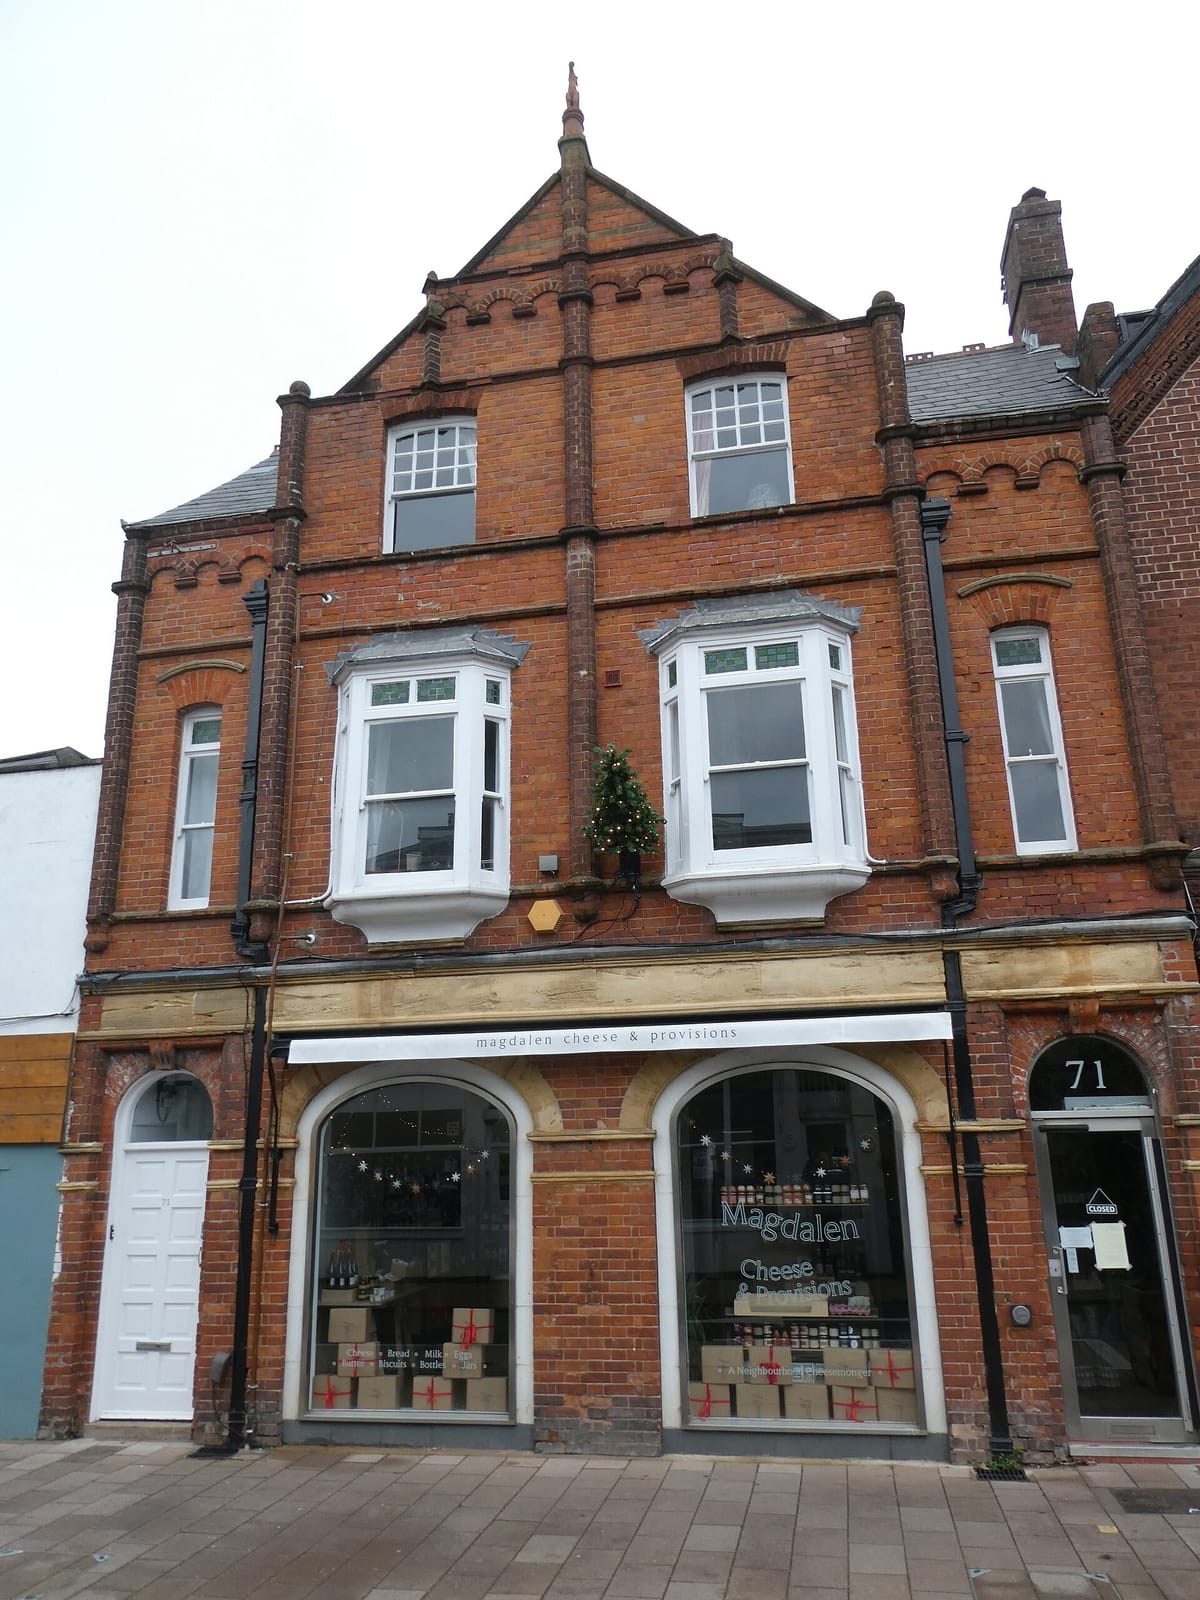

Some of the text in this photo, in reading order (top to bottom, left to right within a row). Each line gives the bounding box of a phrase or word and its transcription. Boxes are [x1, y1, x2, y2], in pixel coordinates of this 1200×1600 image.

[477, 1028, 737, 1049] magdalen cheese & provisions
[1065, 1060, 1107, 1089] 71
[1088, 1205, 1115, 1213] CLOSED
[721, 1200, 860, 1242] Magdalen
[740, 1258, 814, 1281] Cheese
[736, 1280, 853, 1304] & Provisions
[346, 1349, 473, 1361] Cheese Bread Milk Eggs
[378, 1360, 407, 1368] Biscuits
[420, 1361, 446, 1369] Bottles
[460, 1362, 477, 1370] Jars
